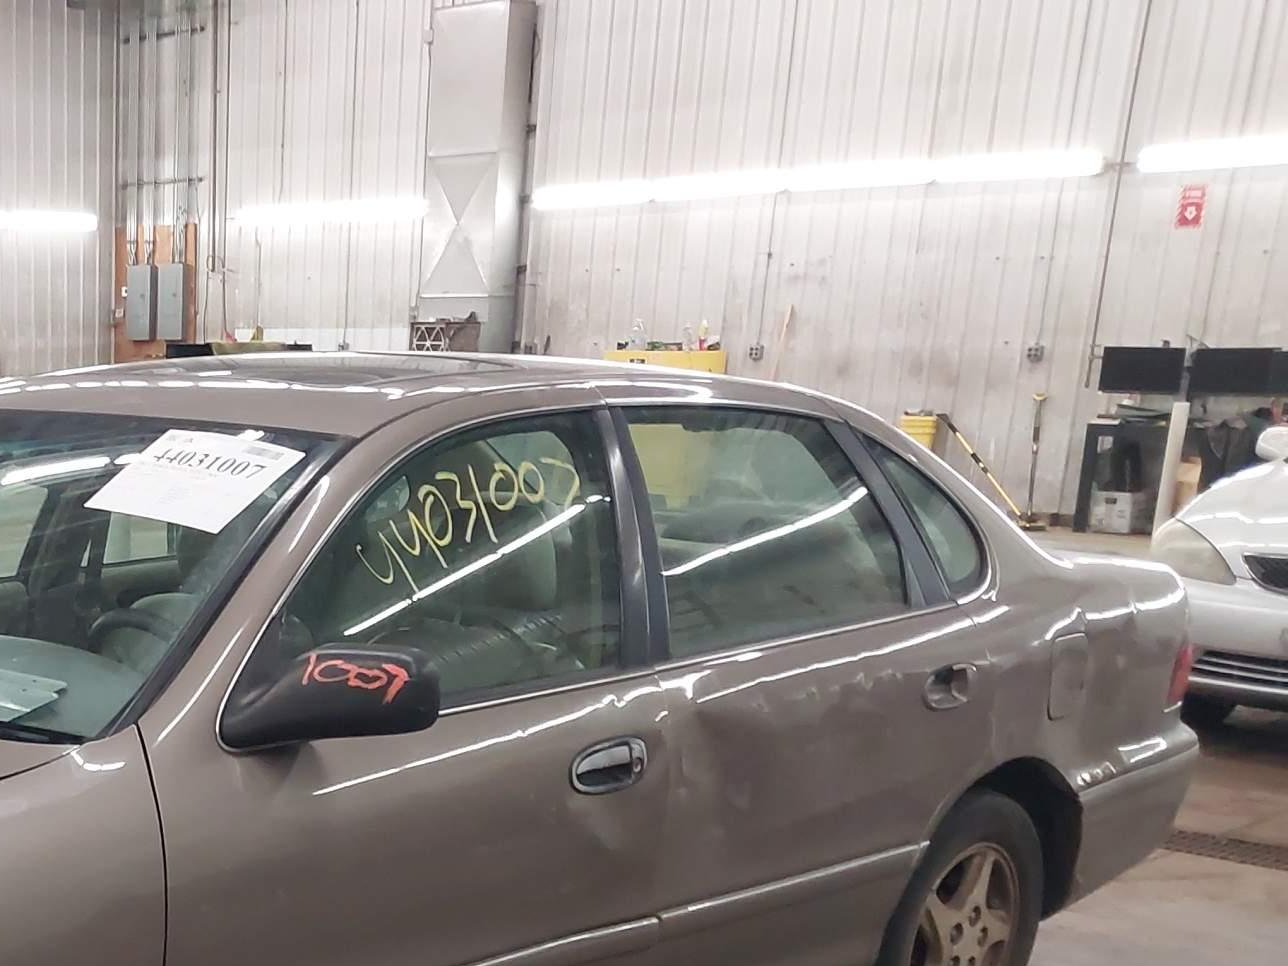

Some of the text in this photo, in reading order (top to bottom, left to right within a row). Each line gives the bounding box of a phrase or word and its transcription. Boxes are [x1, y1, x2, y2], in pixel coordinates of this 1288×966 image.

[153, 447, 268, 479] 44031007
[356, 456, 581, 594] 44031007
[301, 652, 409, 704] 1007
